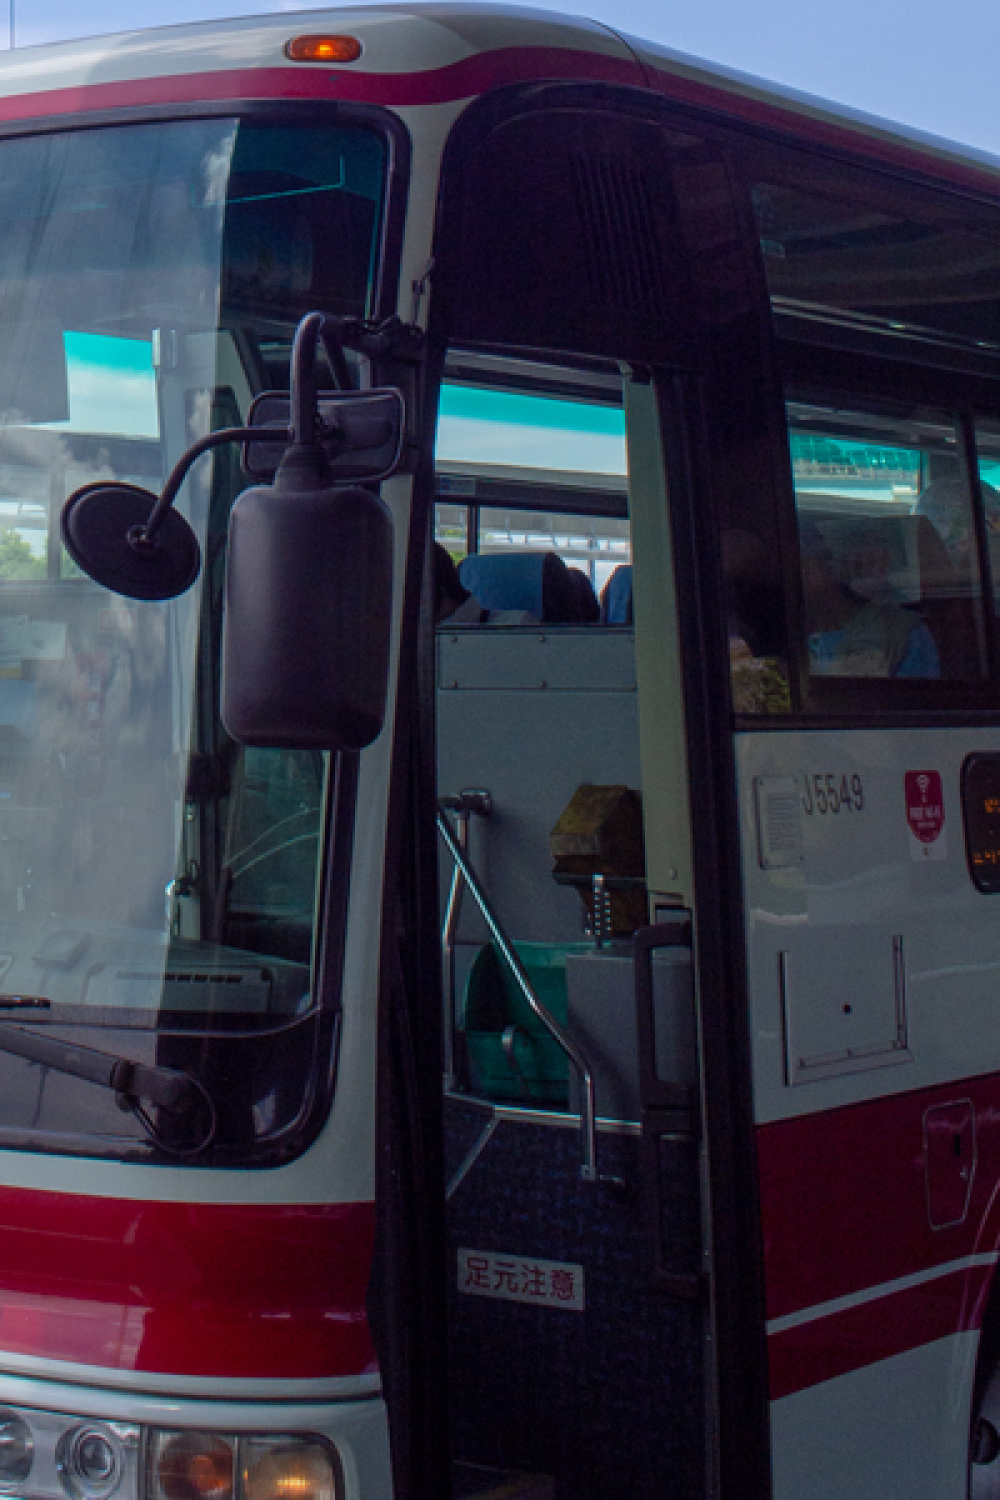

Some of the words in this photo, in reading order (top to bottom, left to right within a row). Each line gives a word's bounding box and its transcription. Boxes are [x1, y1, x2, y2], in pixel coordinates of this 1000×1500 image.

[802, 773, 864, 815] J5549
[466, 1257, 576, 1300] 足元注意
